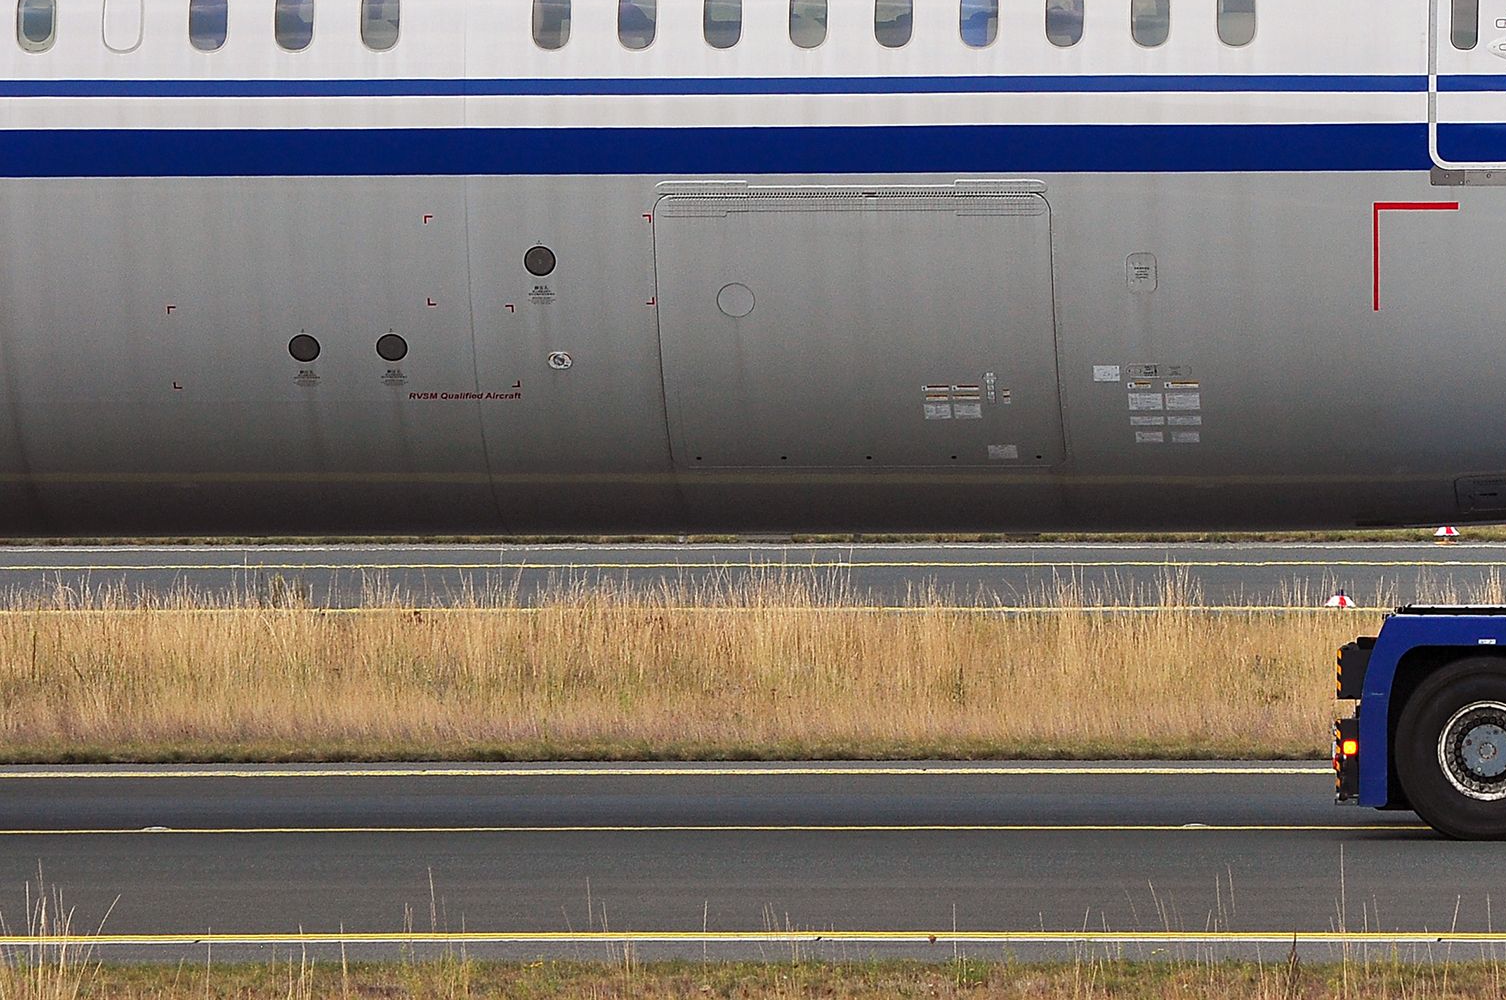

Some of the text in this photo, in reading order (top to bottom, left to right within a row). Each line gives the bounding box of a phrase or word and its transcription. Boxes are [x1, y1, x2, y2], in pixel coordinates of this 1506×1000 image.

[409, 392, 521, 400] RVSM Qualified Aircraft
